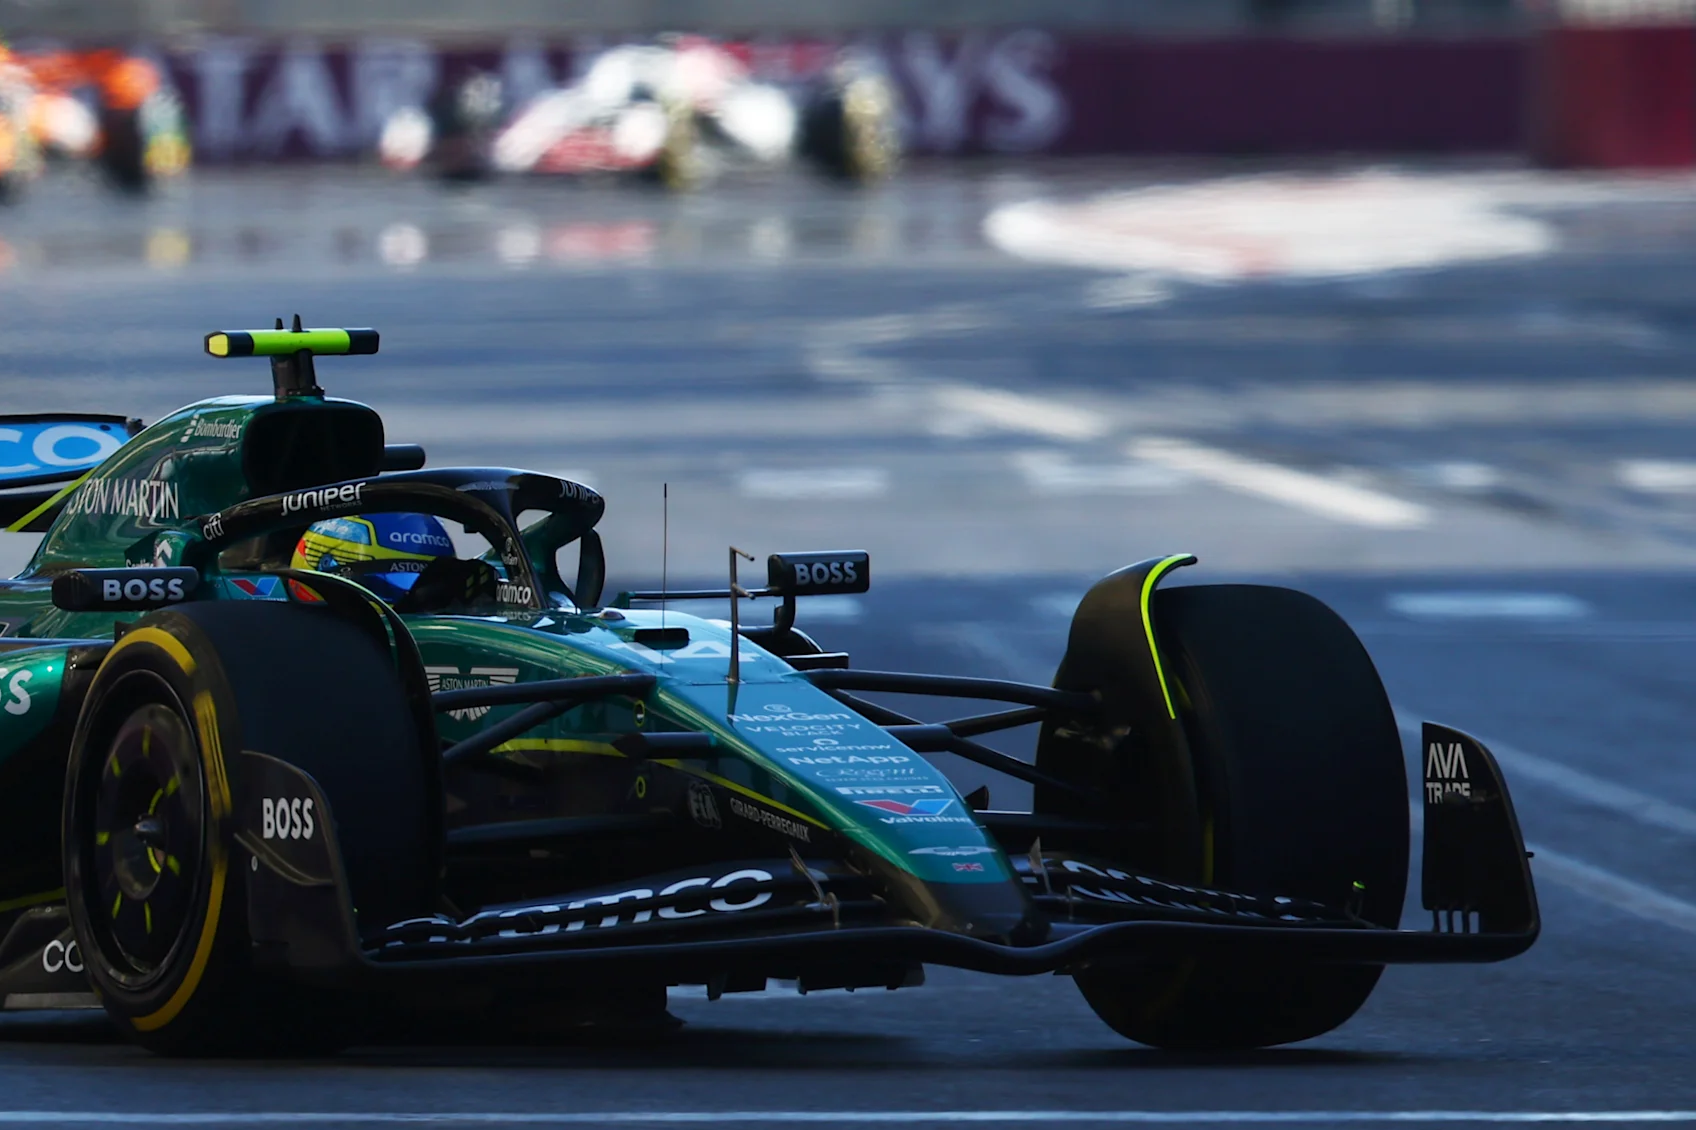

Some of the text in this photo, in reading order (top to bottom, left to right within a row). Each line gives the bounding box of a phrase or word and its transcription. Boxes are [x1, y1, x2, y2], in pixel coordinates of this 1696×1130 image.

[110, 478, 180, 520] MARTIN
[203, 512, 224, 541] citi
[389, 531, 450, 548] aramco
[794, 561, 858, 586] BOSS
[103, 577, 185, 601] BOSS
[496, 584, 532, 605] aramco
[441, 678, 464, 690] ASTON
[728, 712, 851, 722] NexGen
[745, 723, 861, 733] VELOCITY
[788, 755, 911, 766] NetApp
[1426, 742, 1469, 779] AVA
[261, 797, 315, 840] BOSS
